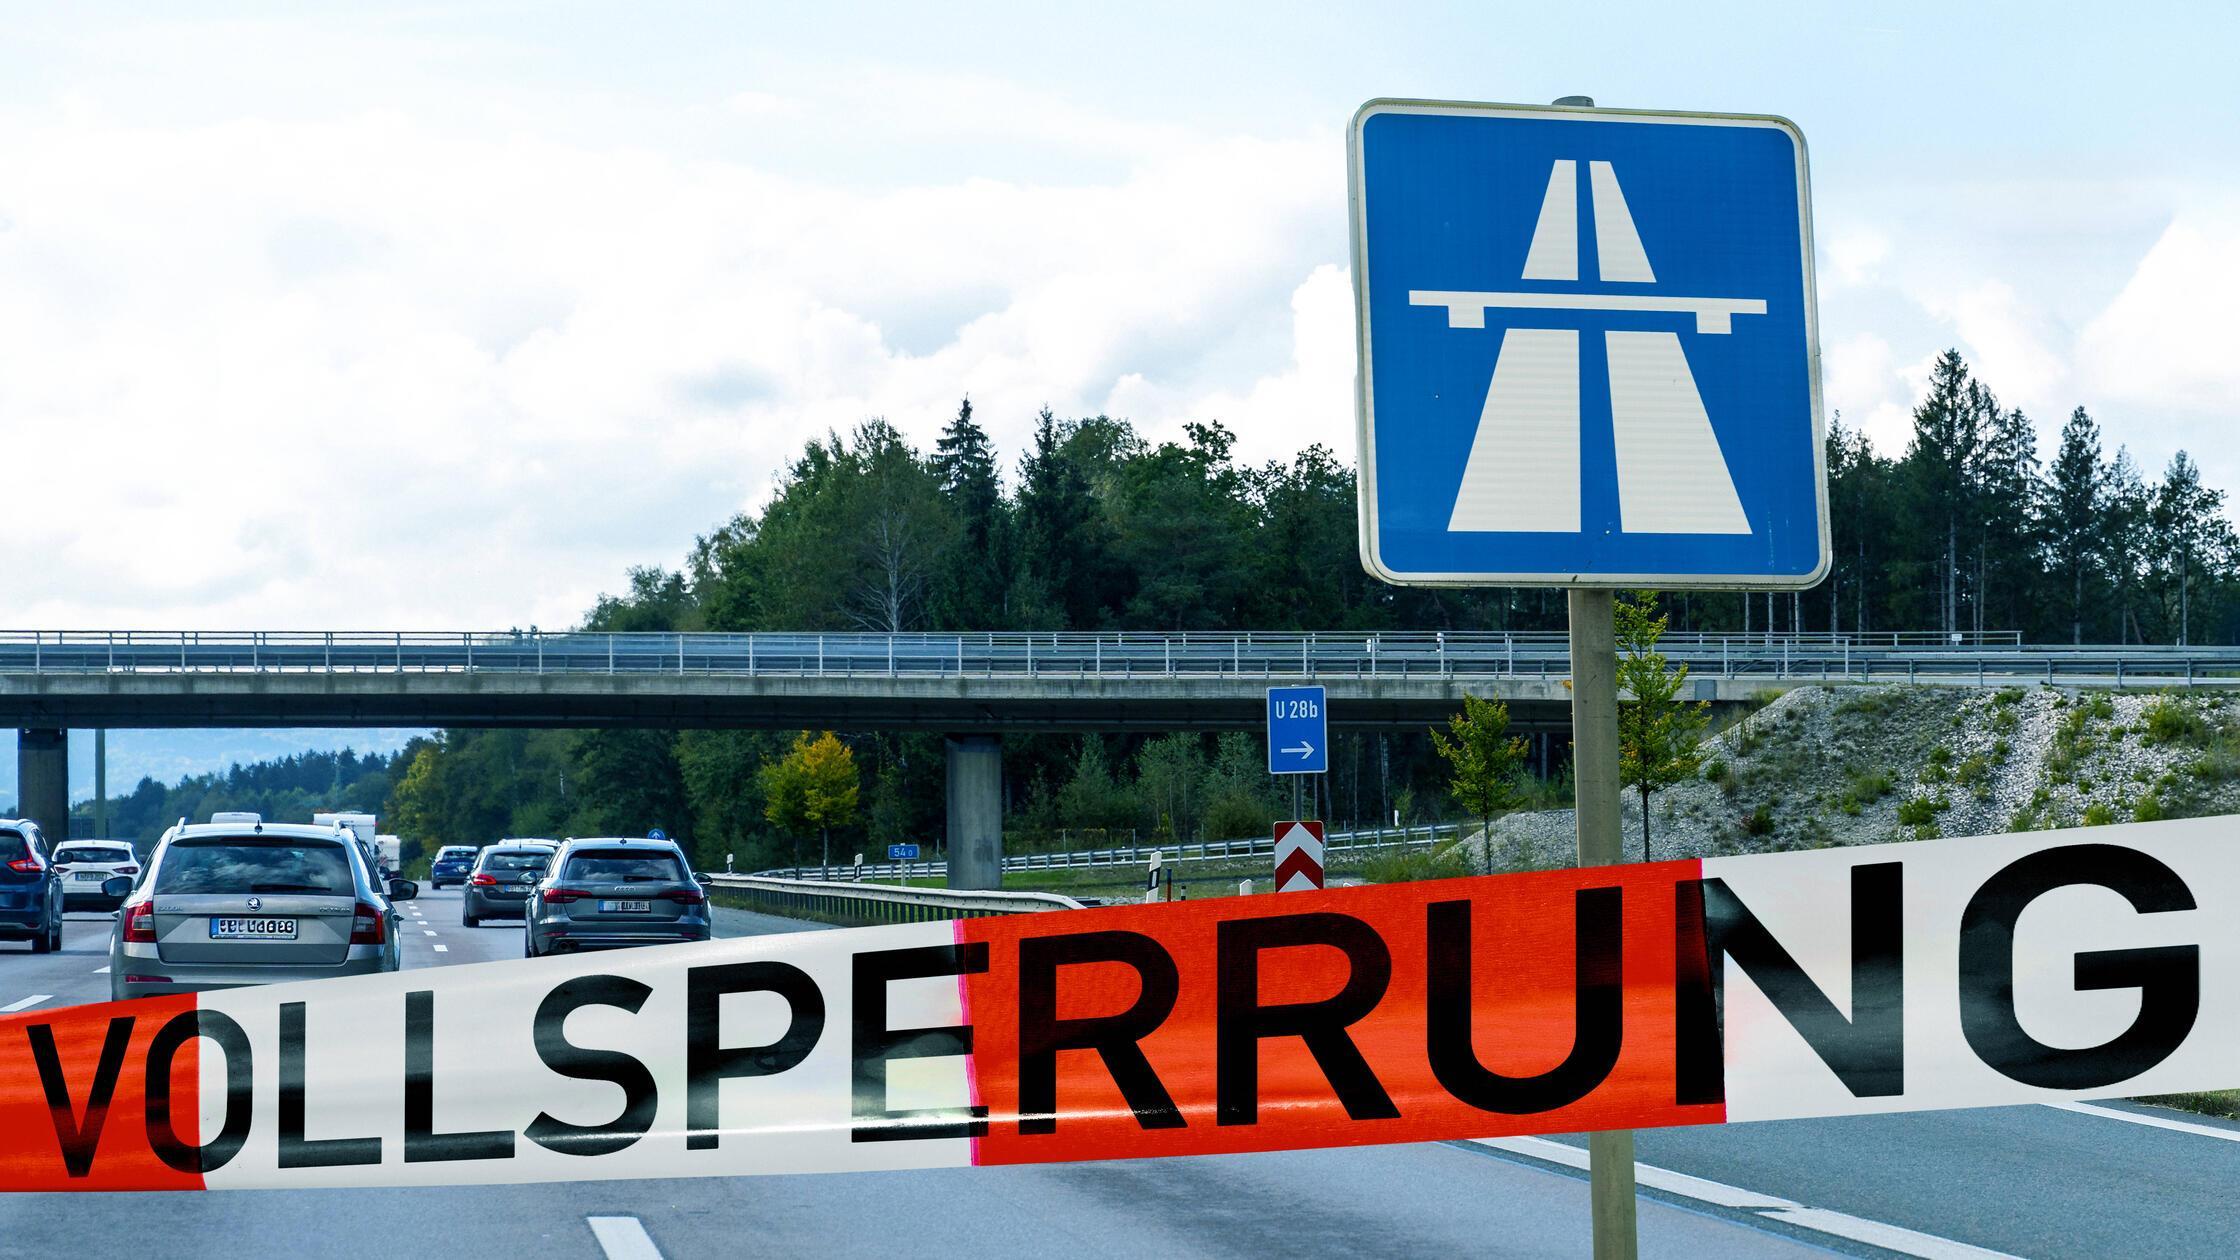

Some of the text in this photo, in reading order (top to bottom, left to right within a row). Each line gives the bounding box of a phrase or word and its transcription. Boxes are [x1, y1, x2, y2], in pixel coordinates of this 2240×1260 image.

[1276, 700, 1318, 719] U 28b
[894, 847, 906, 857] 54
[25, 842, 2201, 1179] VOLLSPERRUNG
